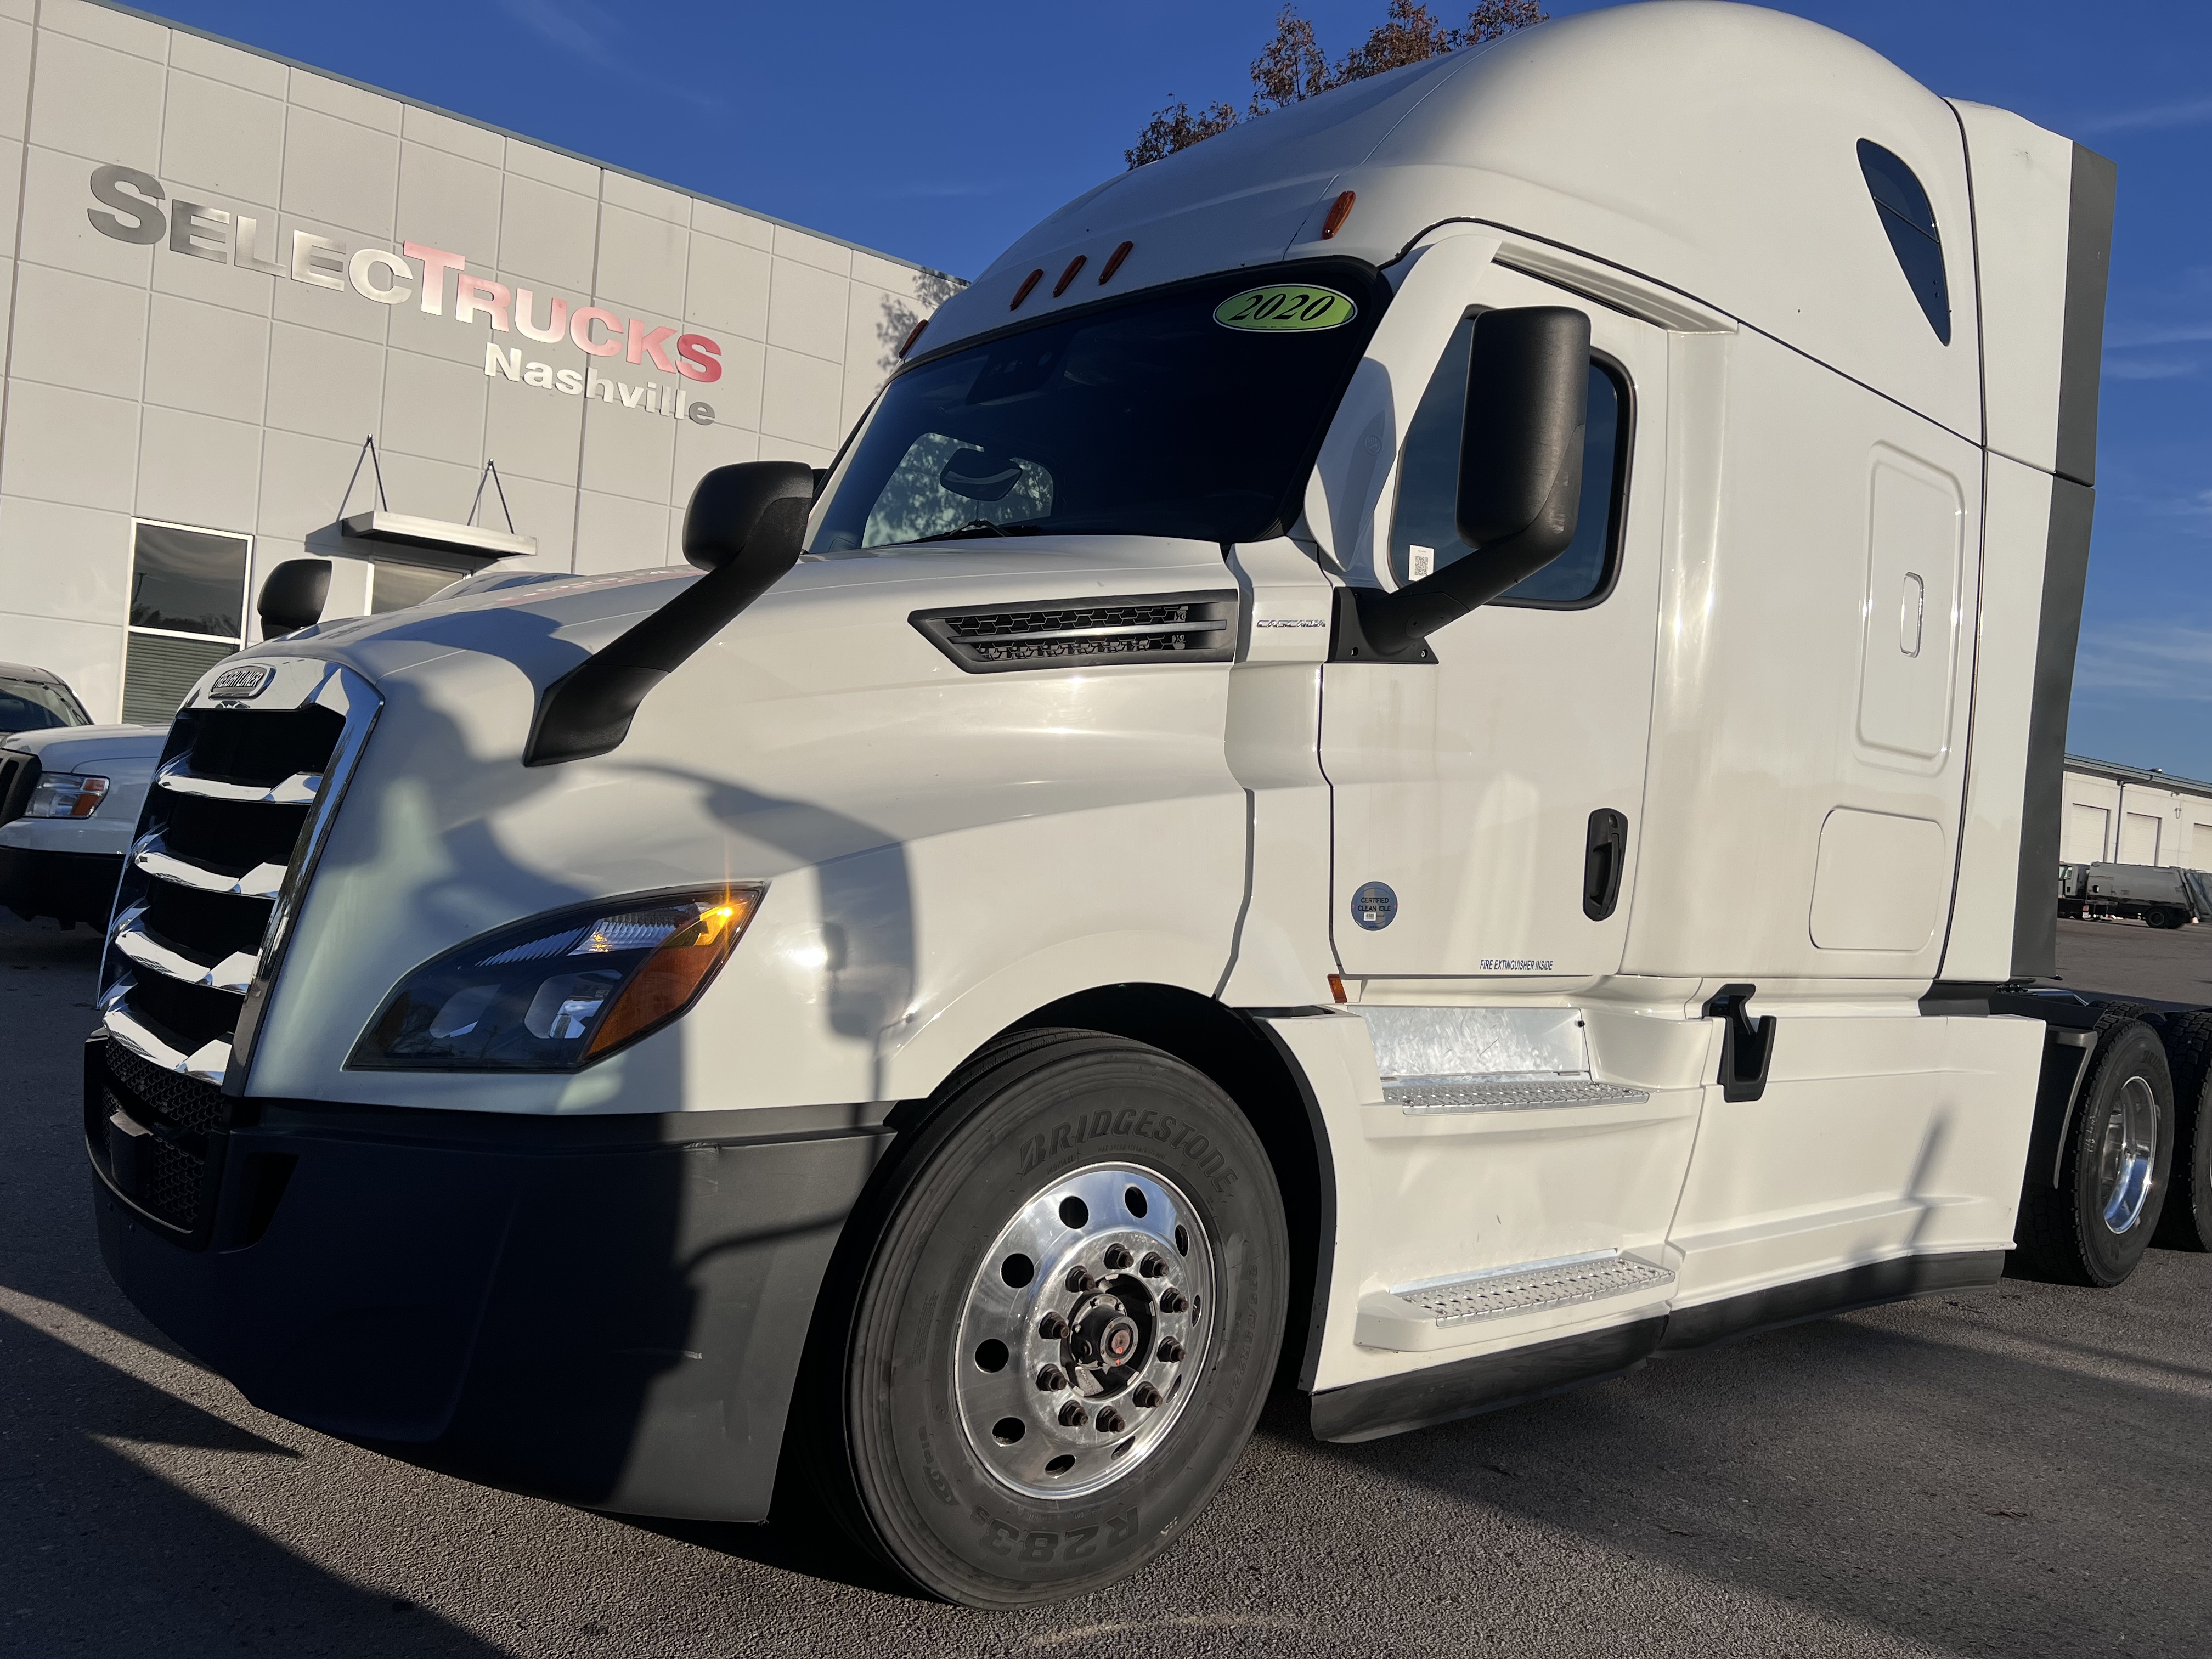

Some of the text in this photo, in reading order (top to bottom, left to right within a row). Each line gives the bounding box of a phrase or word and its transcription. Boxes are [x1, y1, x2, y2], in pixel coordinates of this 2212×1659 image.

[87, 163, 723, 383] SELECTRUCKS
[1227, 293, 1335, 321] 2020
[484, 341, 716, 426] Nashville
[1480, 959, 1554, 970] FIRE EXTINGUISHER INSIDE
[1019, 1107, 1239, 1193] BRIDGESTONE
